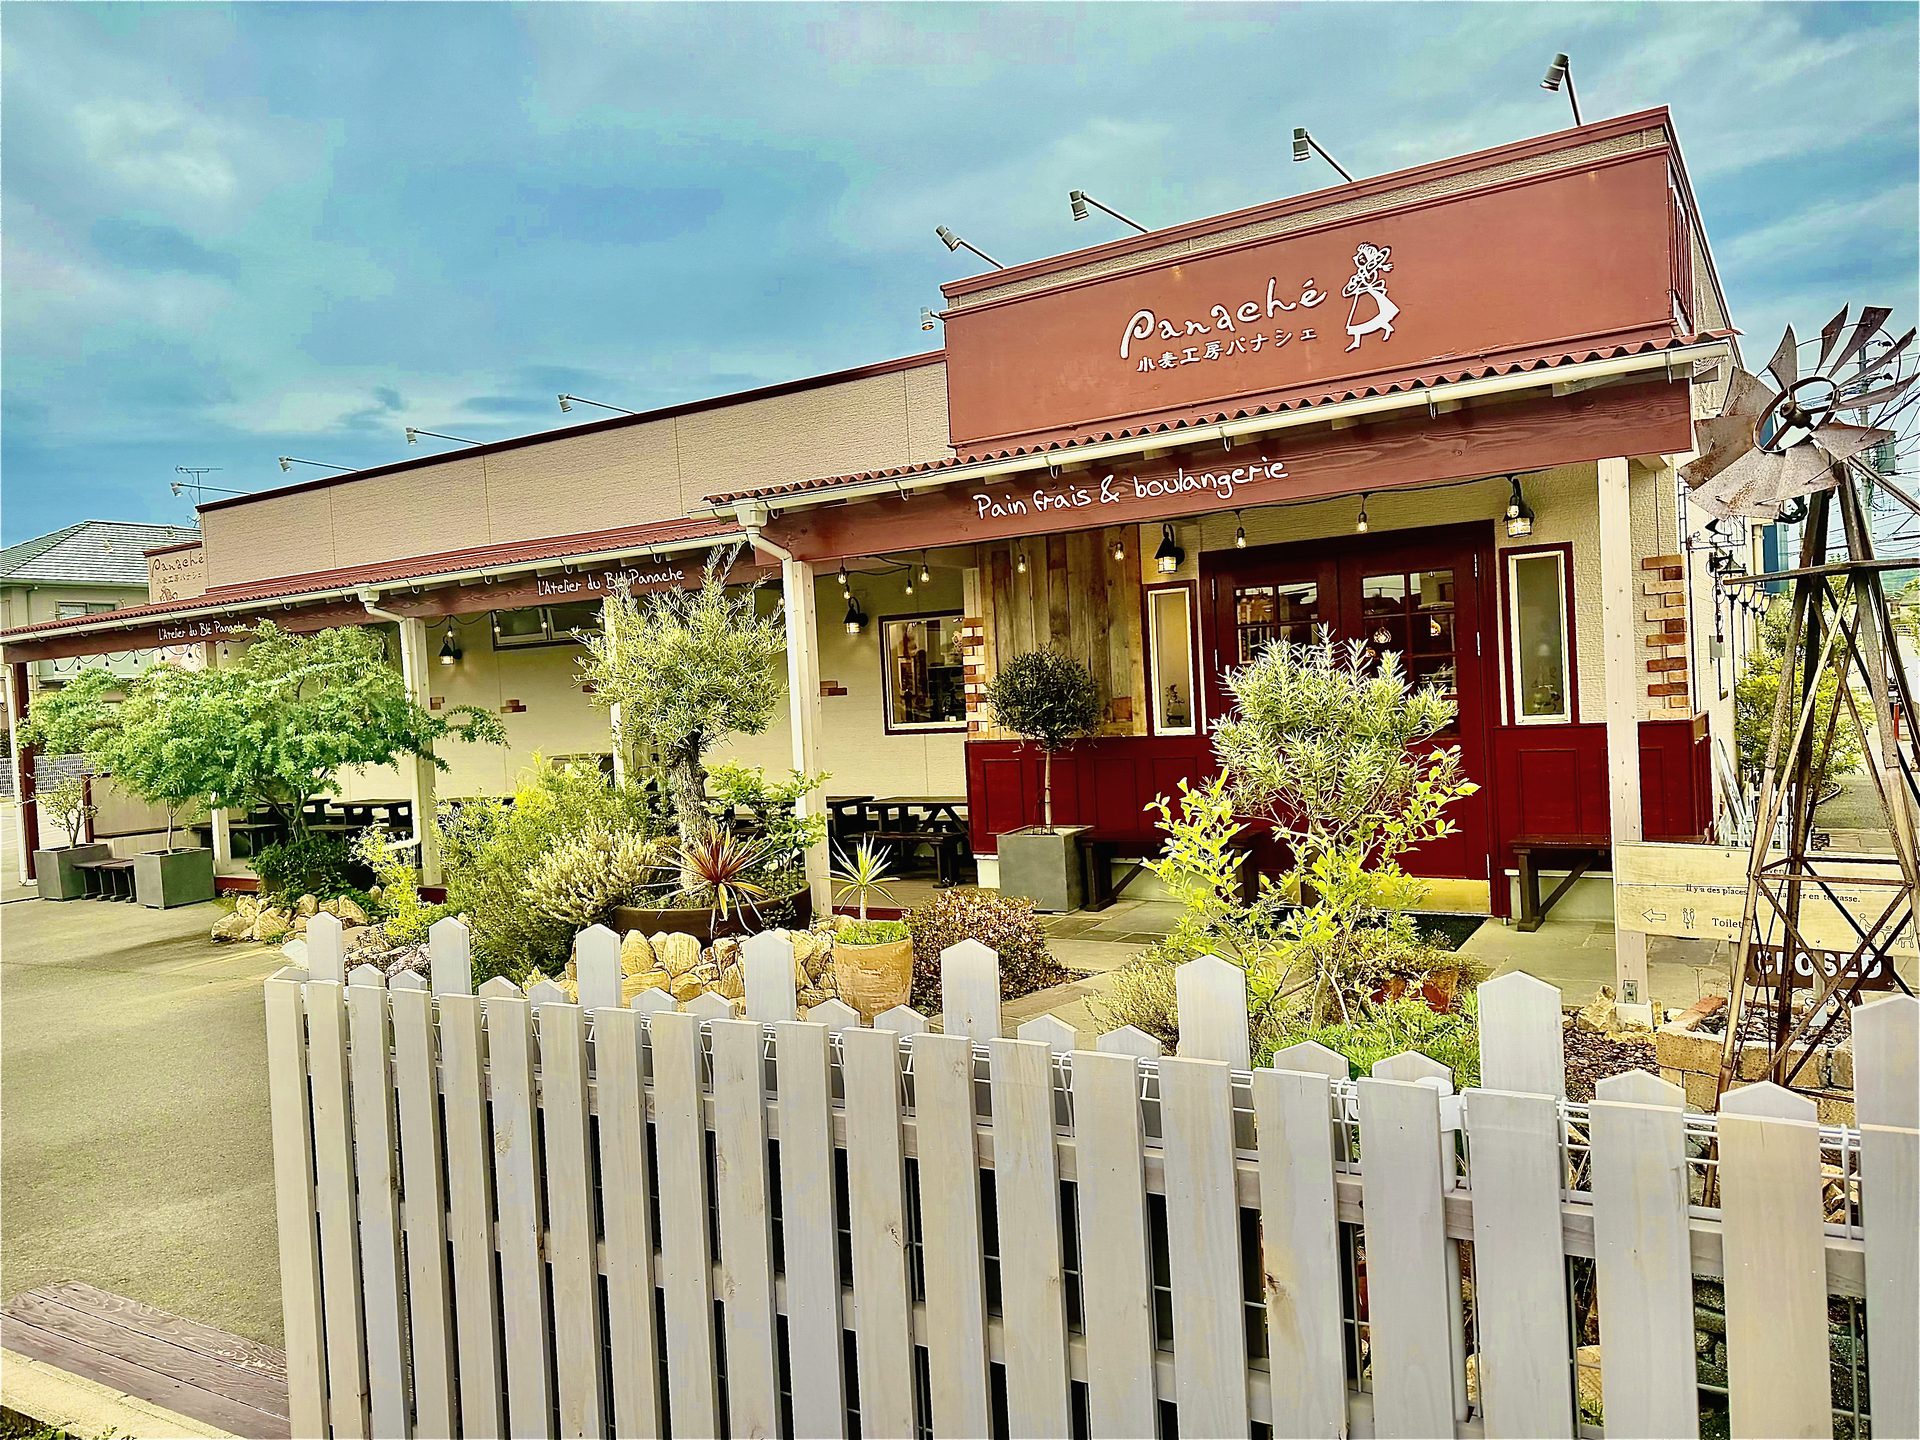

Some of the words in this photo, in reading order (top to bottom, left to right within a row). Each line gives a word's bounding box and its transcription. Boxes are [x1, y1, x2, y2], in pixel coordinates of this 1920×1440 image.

[1120, 277, 1328, 359] Panaché
[1136, 327, 1318, 373] 小麦工房パナシェ
[973, 493, 1027, 520] Pain
[1033, 485, 1092, 512] frais
[1099, 474, 1121, 504] &
[1133, 456, 1289, 500] boulangerie
[151, 550, 204, 578] Panaché
[537, 579, 582, 597] L'Atelier
[587, 574, 601, 591] du
[158, 627, 186, 640] L'Atelier
[189, 623, 198, 637] du
[1823, 893, 1861, 903] terasse.
